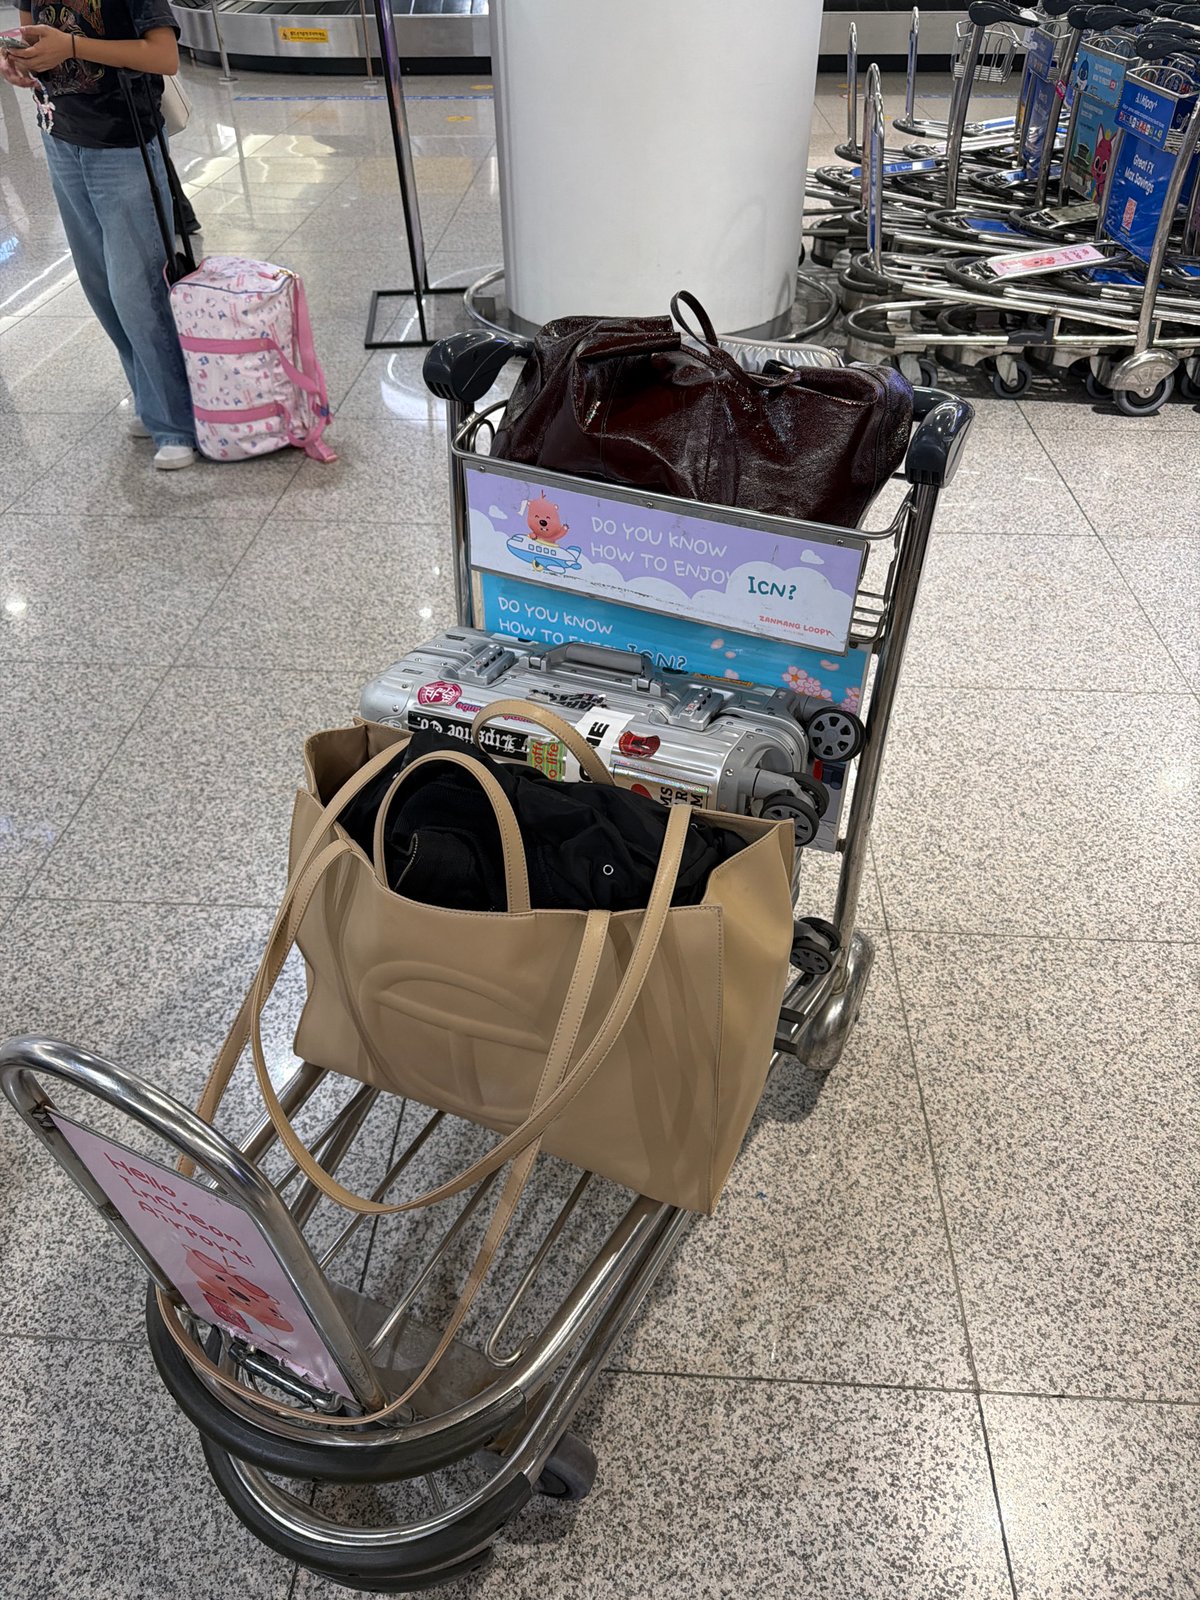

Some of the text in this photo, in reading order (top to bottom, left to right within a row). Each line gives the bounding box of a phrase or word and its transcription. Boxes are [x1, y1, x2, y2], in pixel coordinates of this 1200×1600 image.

[1133, 154, 1155, 175] Great FX
[1133, 172, 1155, 196] Savings
[591, 516, 727, 557] DO YOU KNOW
[591, 542, 634, 562] HOW
[640, 553, 667, 571] TO
[748, 576, 797, 600] ICN?
[498, 597, 613, 634] DO YOU KNOW
[499, 618, 536, 637] HOW
[541, 629, 564, 645] TO
[760, 615, 800, 629] ZANMANG
[803, 624, 831, 636] LOOPY
[119, 1175, 242, 1247] Incheon
[138, 1200, 255, 1268] Airport!
